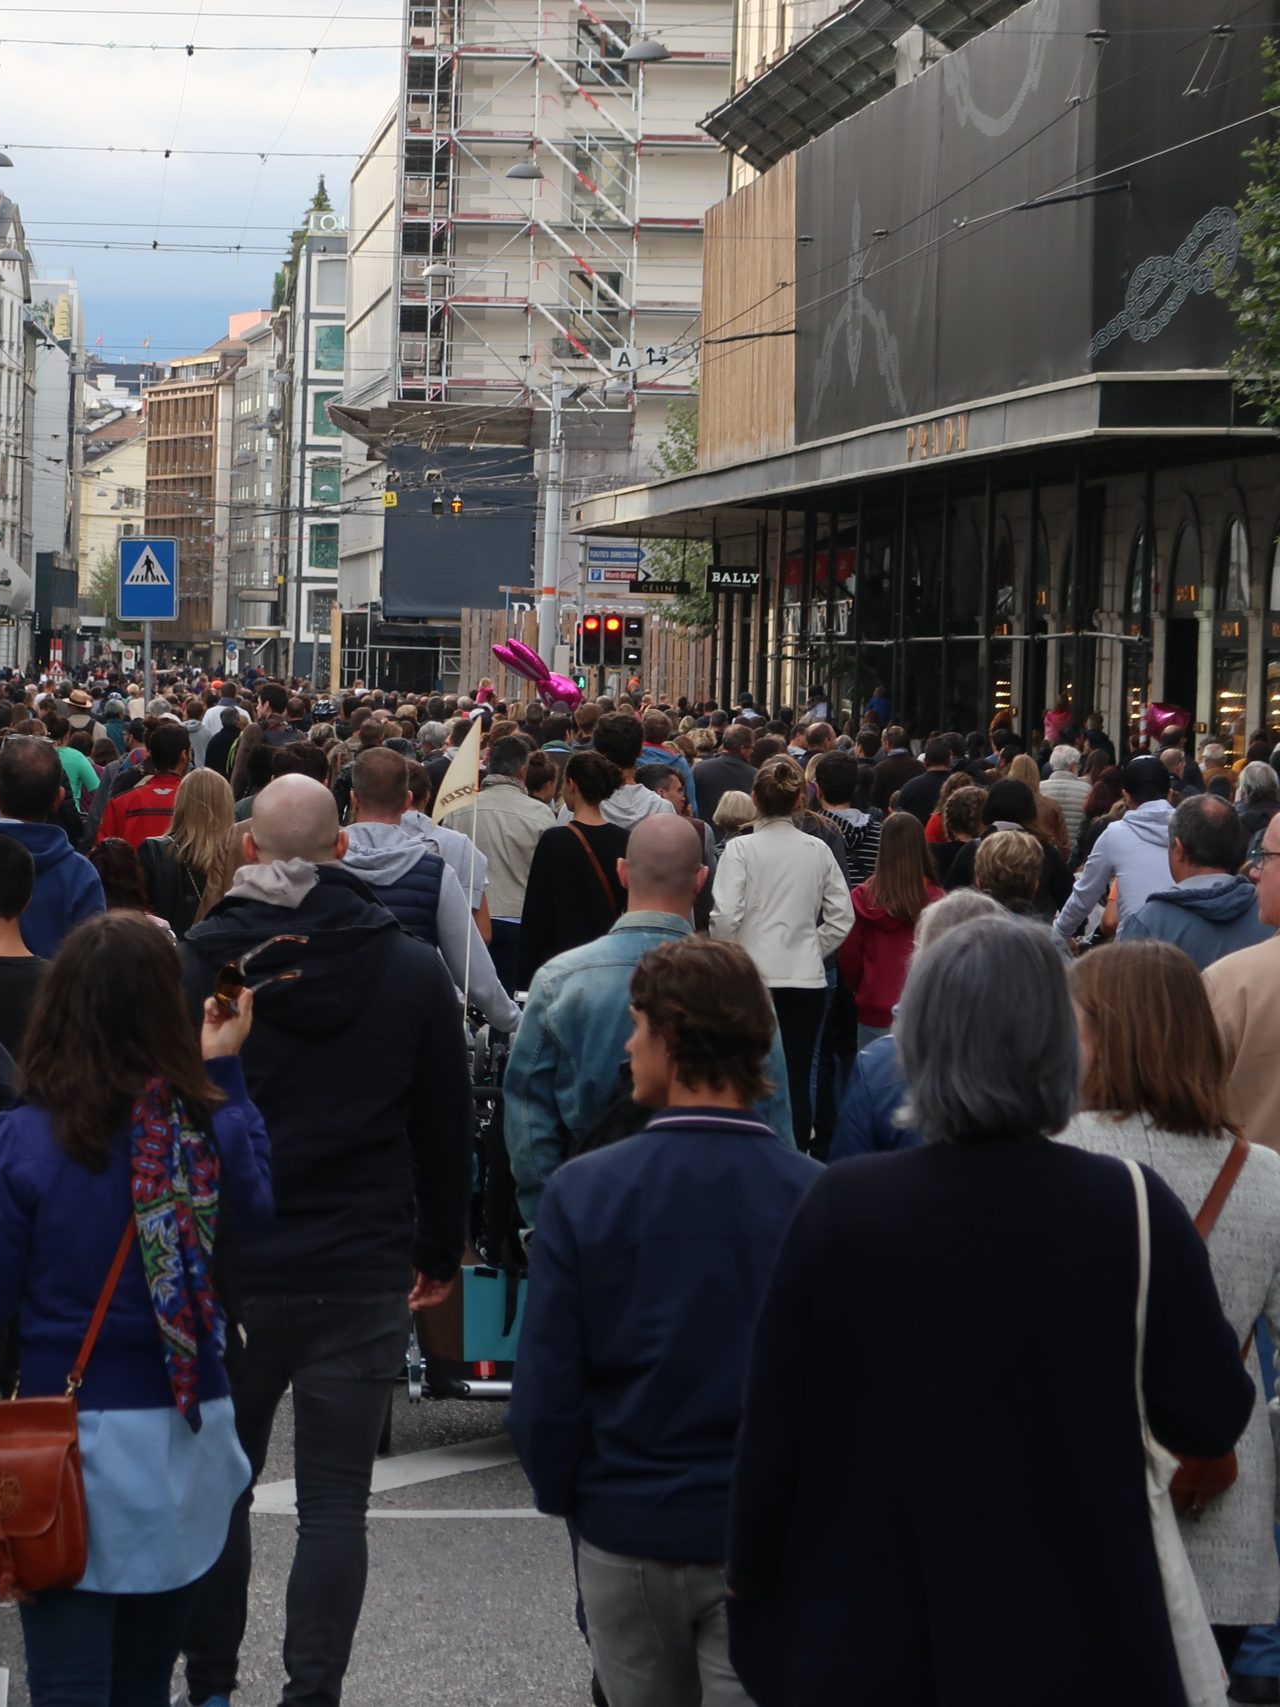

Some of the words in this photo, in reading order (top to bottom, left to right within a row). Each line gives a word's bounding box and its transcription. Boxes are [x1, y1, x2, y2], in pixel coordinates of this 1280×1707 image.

[617, 351, 631, 367] A
[906, 415, 968, 461] PRADA
[711, 571, 760, 584] BALLY
